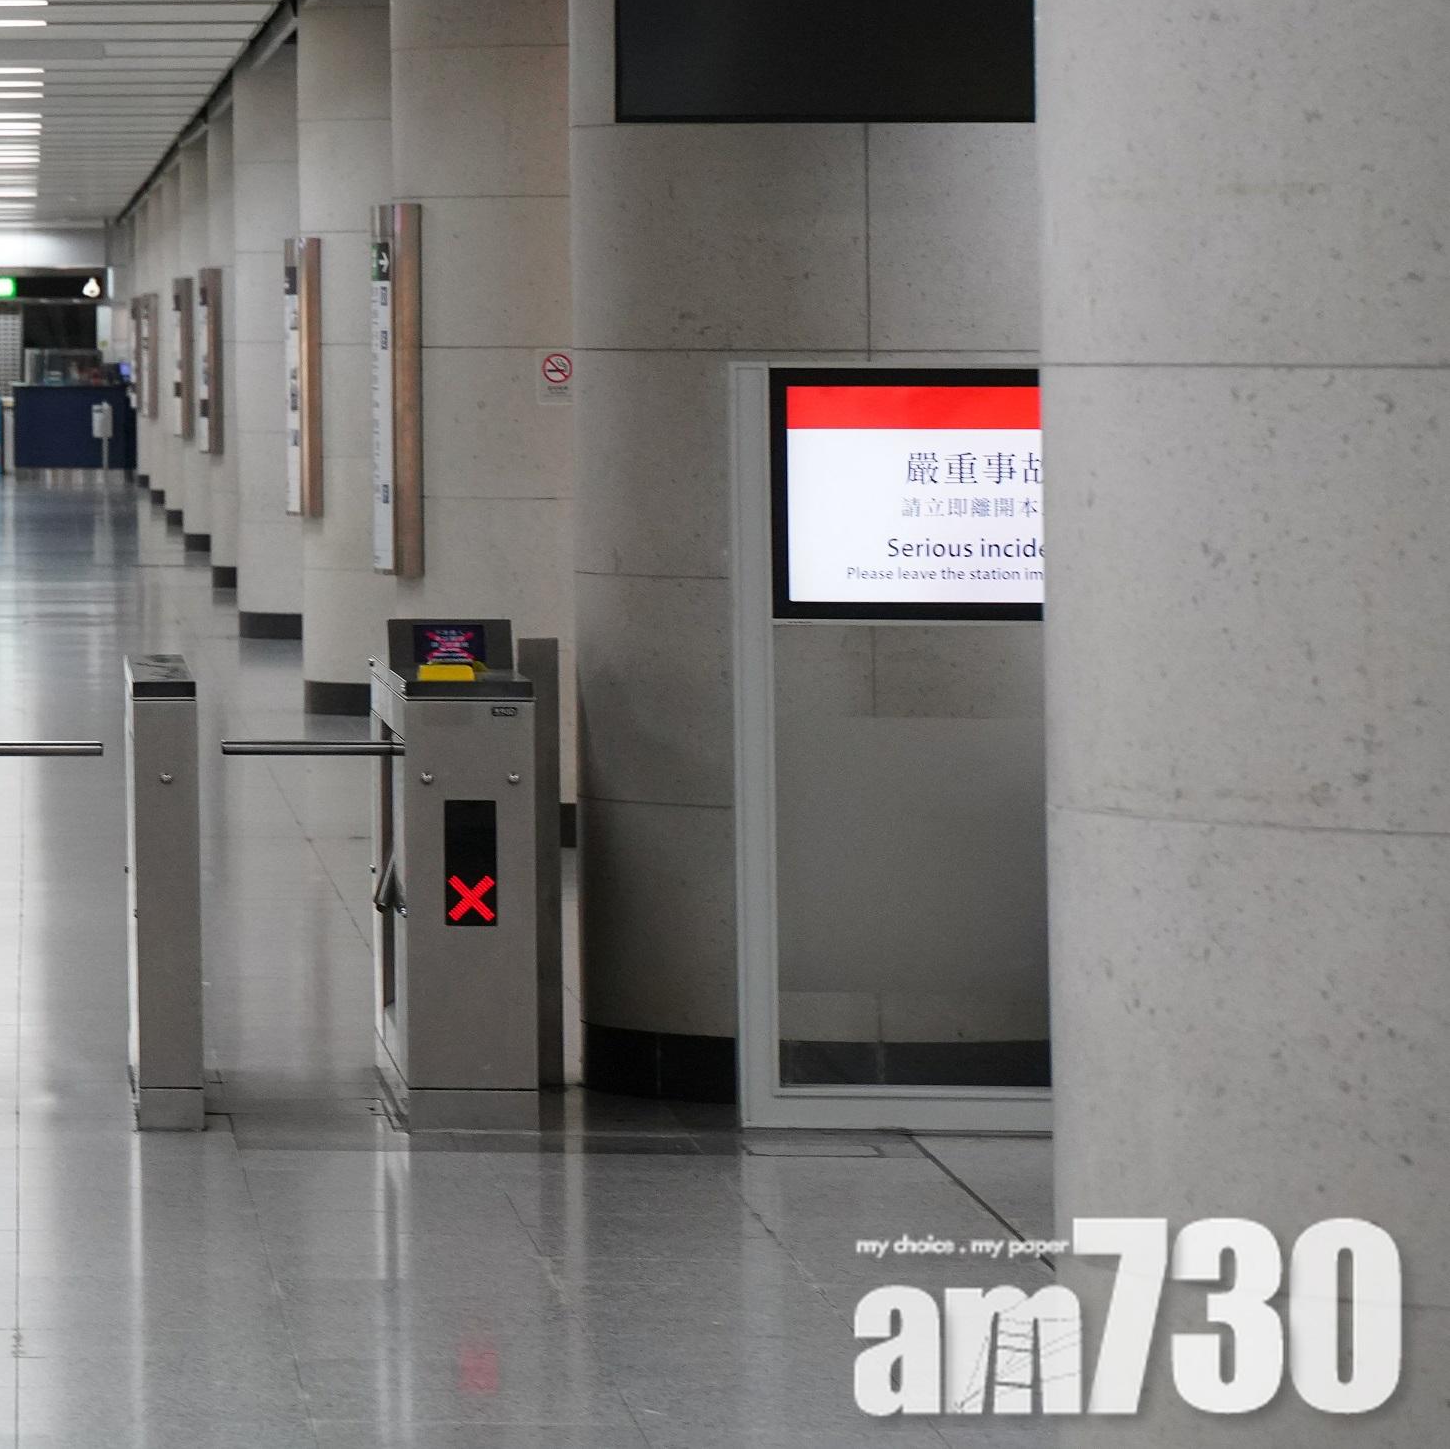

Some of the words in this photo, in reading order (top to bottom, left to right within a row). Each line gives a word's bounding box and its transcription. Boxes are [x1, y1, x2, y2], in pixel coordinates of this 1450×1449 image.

[887, 538, 973, 558] Serious
[847, 567, 894, 581] Please
[898, 567, 937, 581] leave
[941, 567, 965, 581] the
[969, 567, 1021, 581] station
